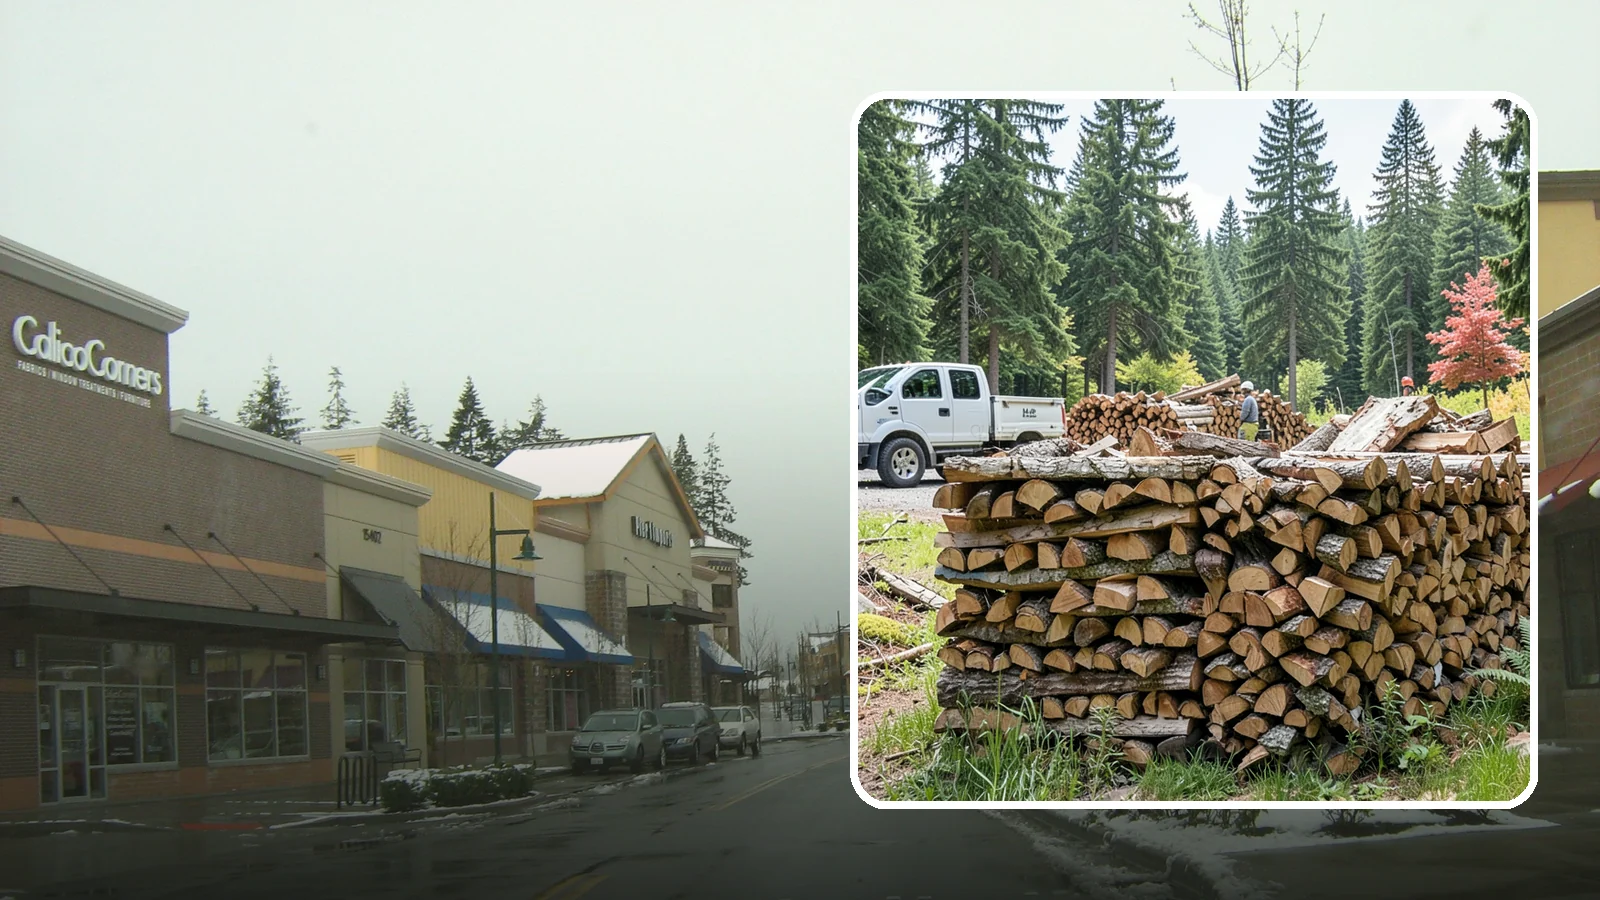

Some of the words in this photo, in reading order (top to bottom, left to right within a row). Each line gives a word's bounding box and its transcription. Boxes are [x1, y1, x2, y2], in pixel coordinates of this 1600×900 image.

[17, 360, 47, 378] FABRICS
[51, 370, 78, 387] WINDOW
[78, 378, 117, 399] TREATMENTS
[120, 391, 152, 409] FURNITURE
